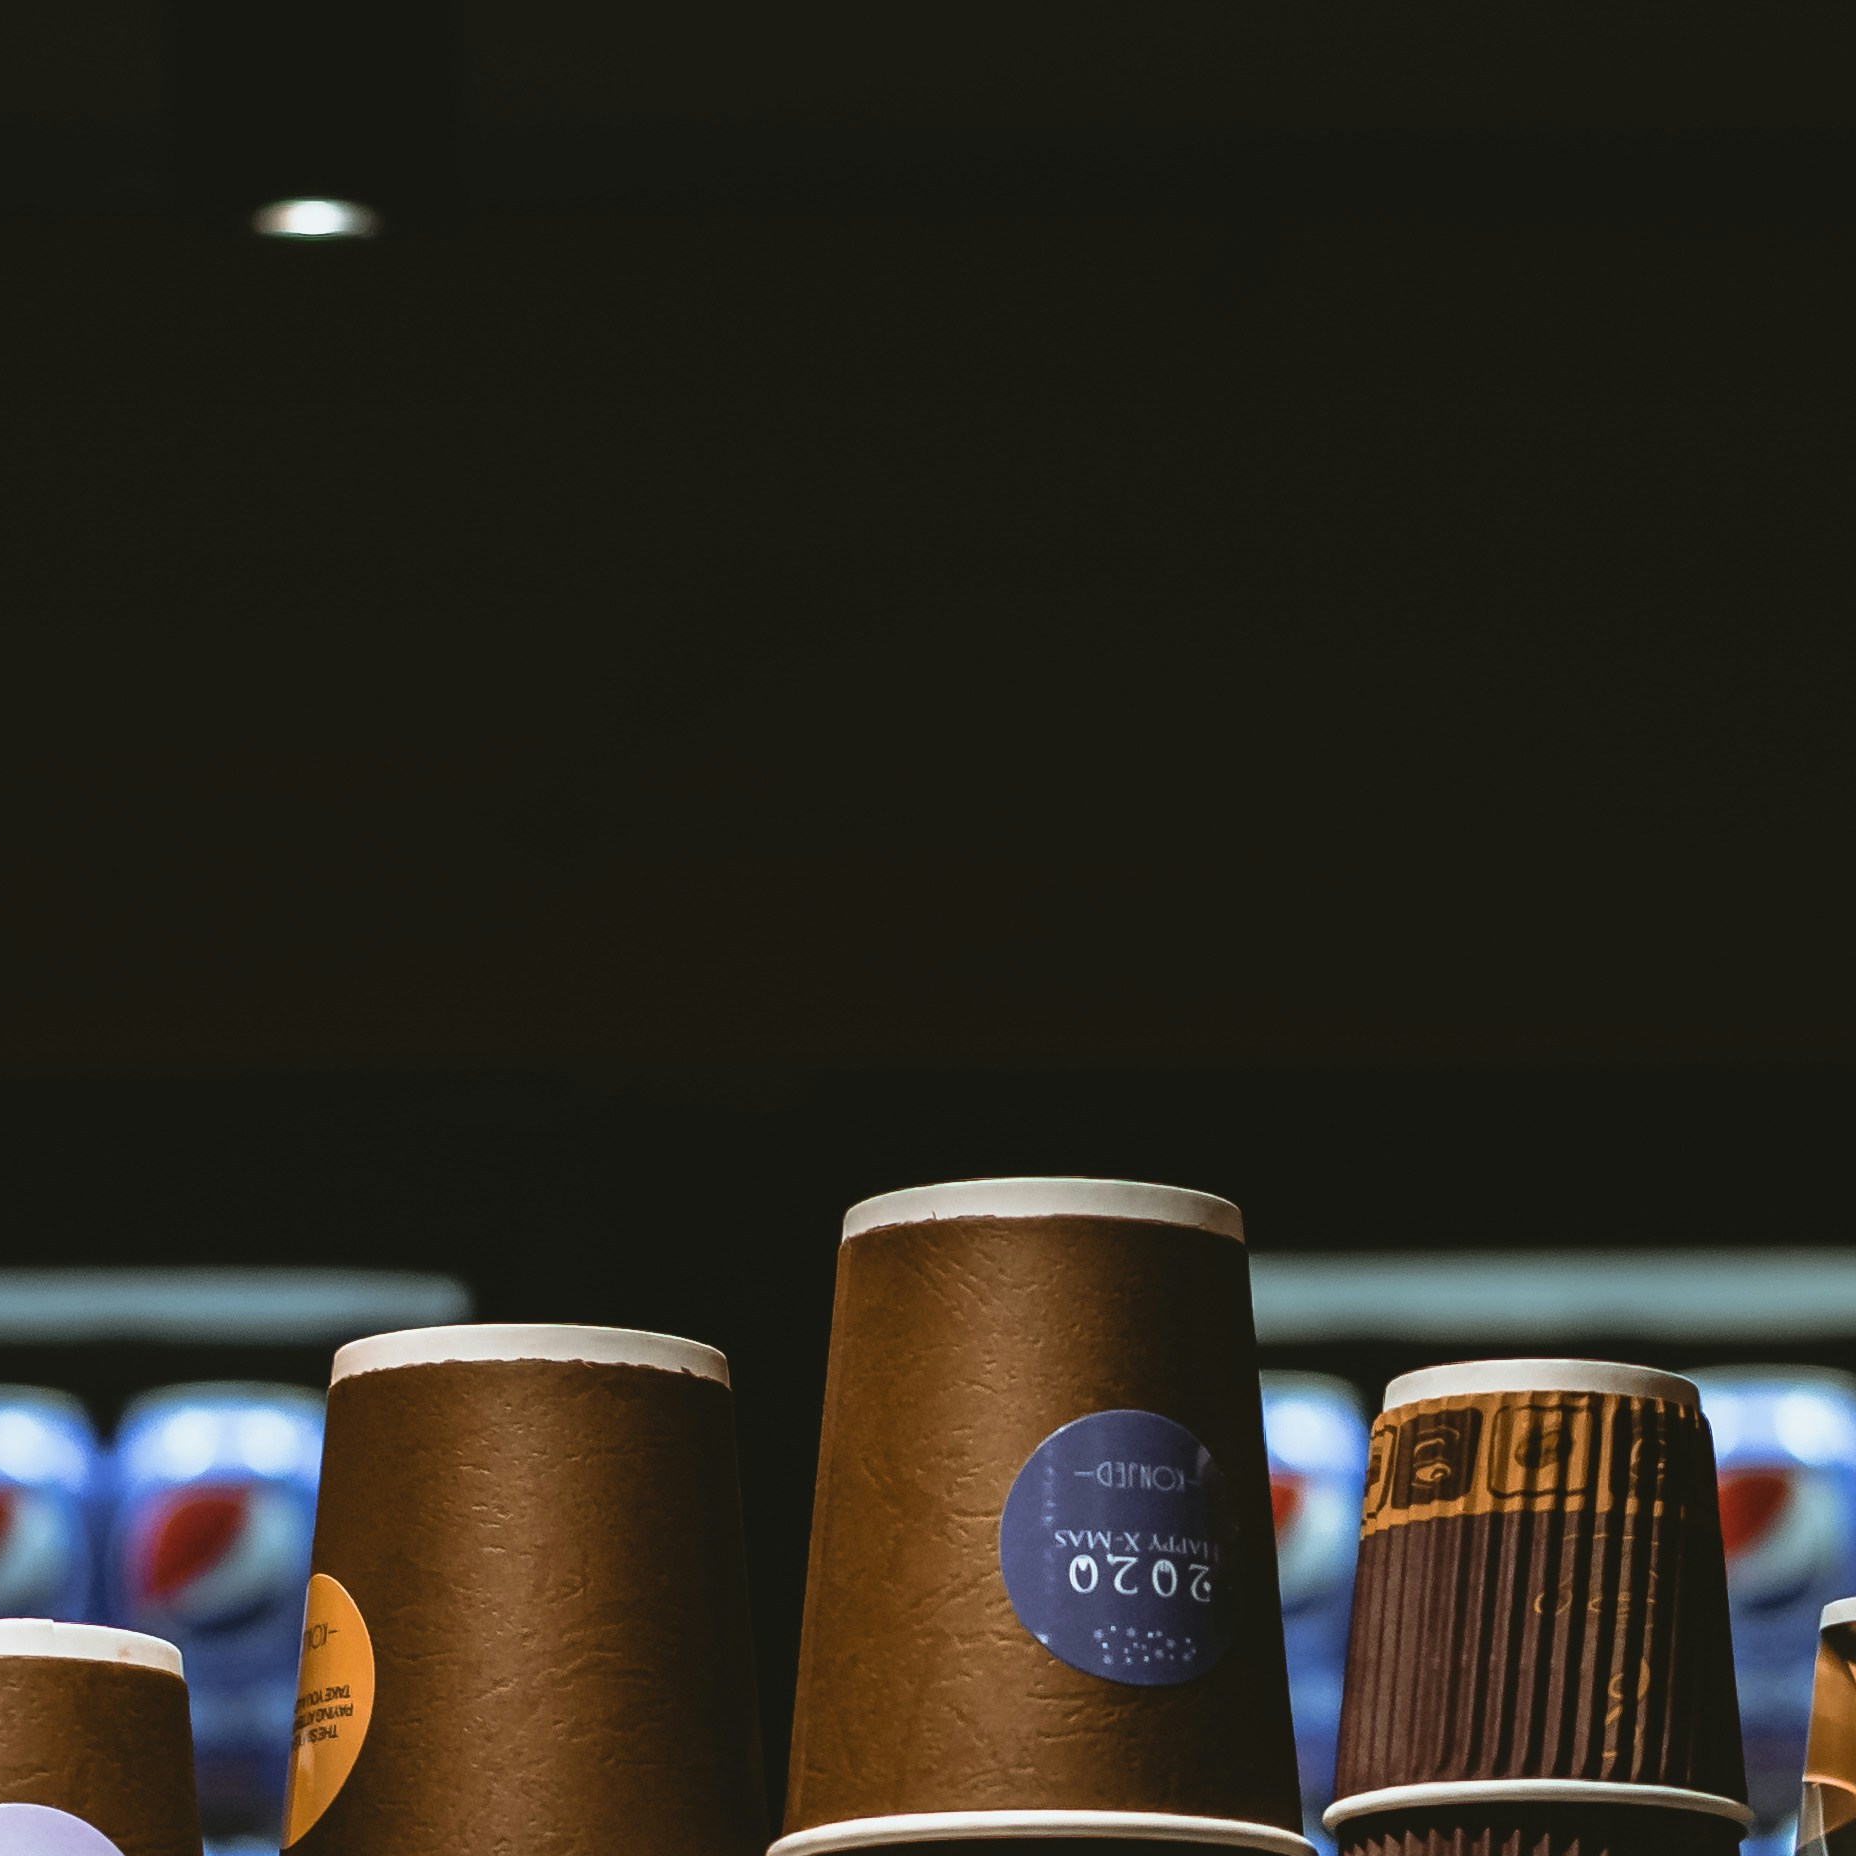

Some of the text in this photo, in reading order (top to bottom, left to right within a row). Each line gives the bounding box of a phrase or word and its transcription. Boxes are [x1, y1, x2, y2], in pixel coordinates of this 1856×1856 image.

[1054, 1528, 1220, 1564] HAPPY X-MAS
[1069, 1553, 1212, 1603] 2020
